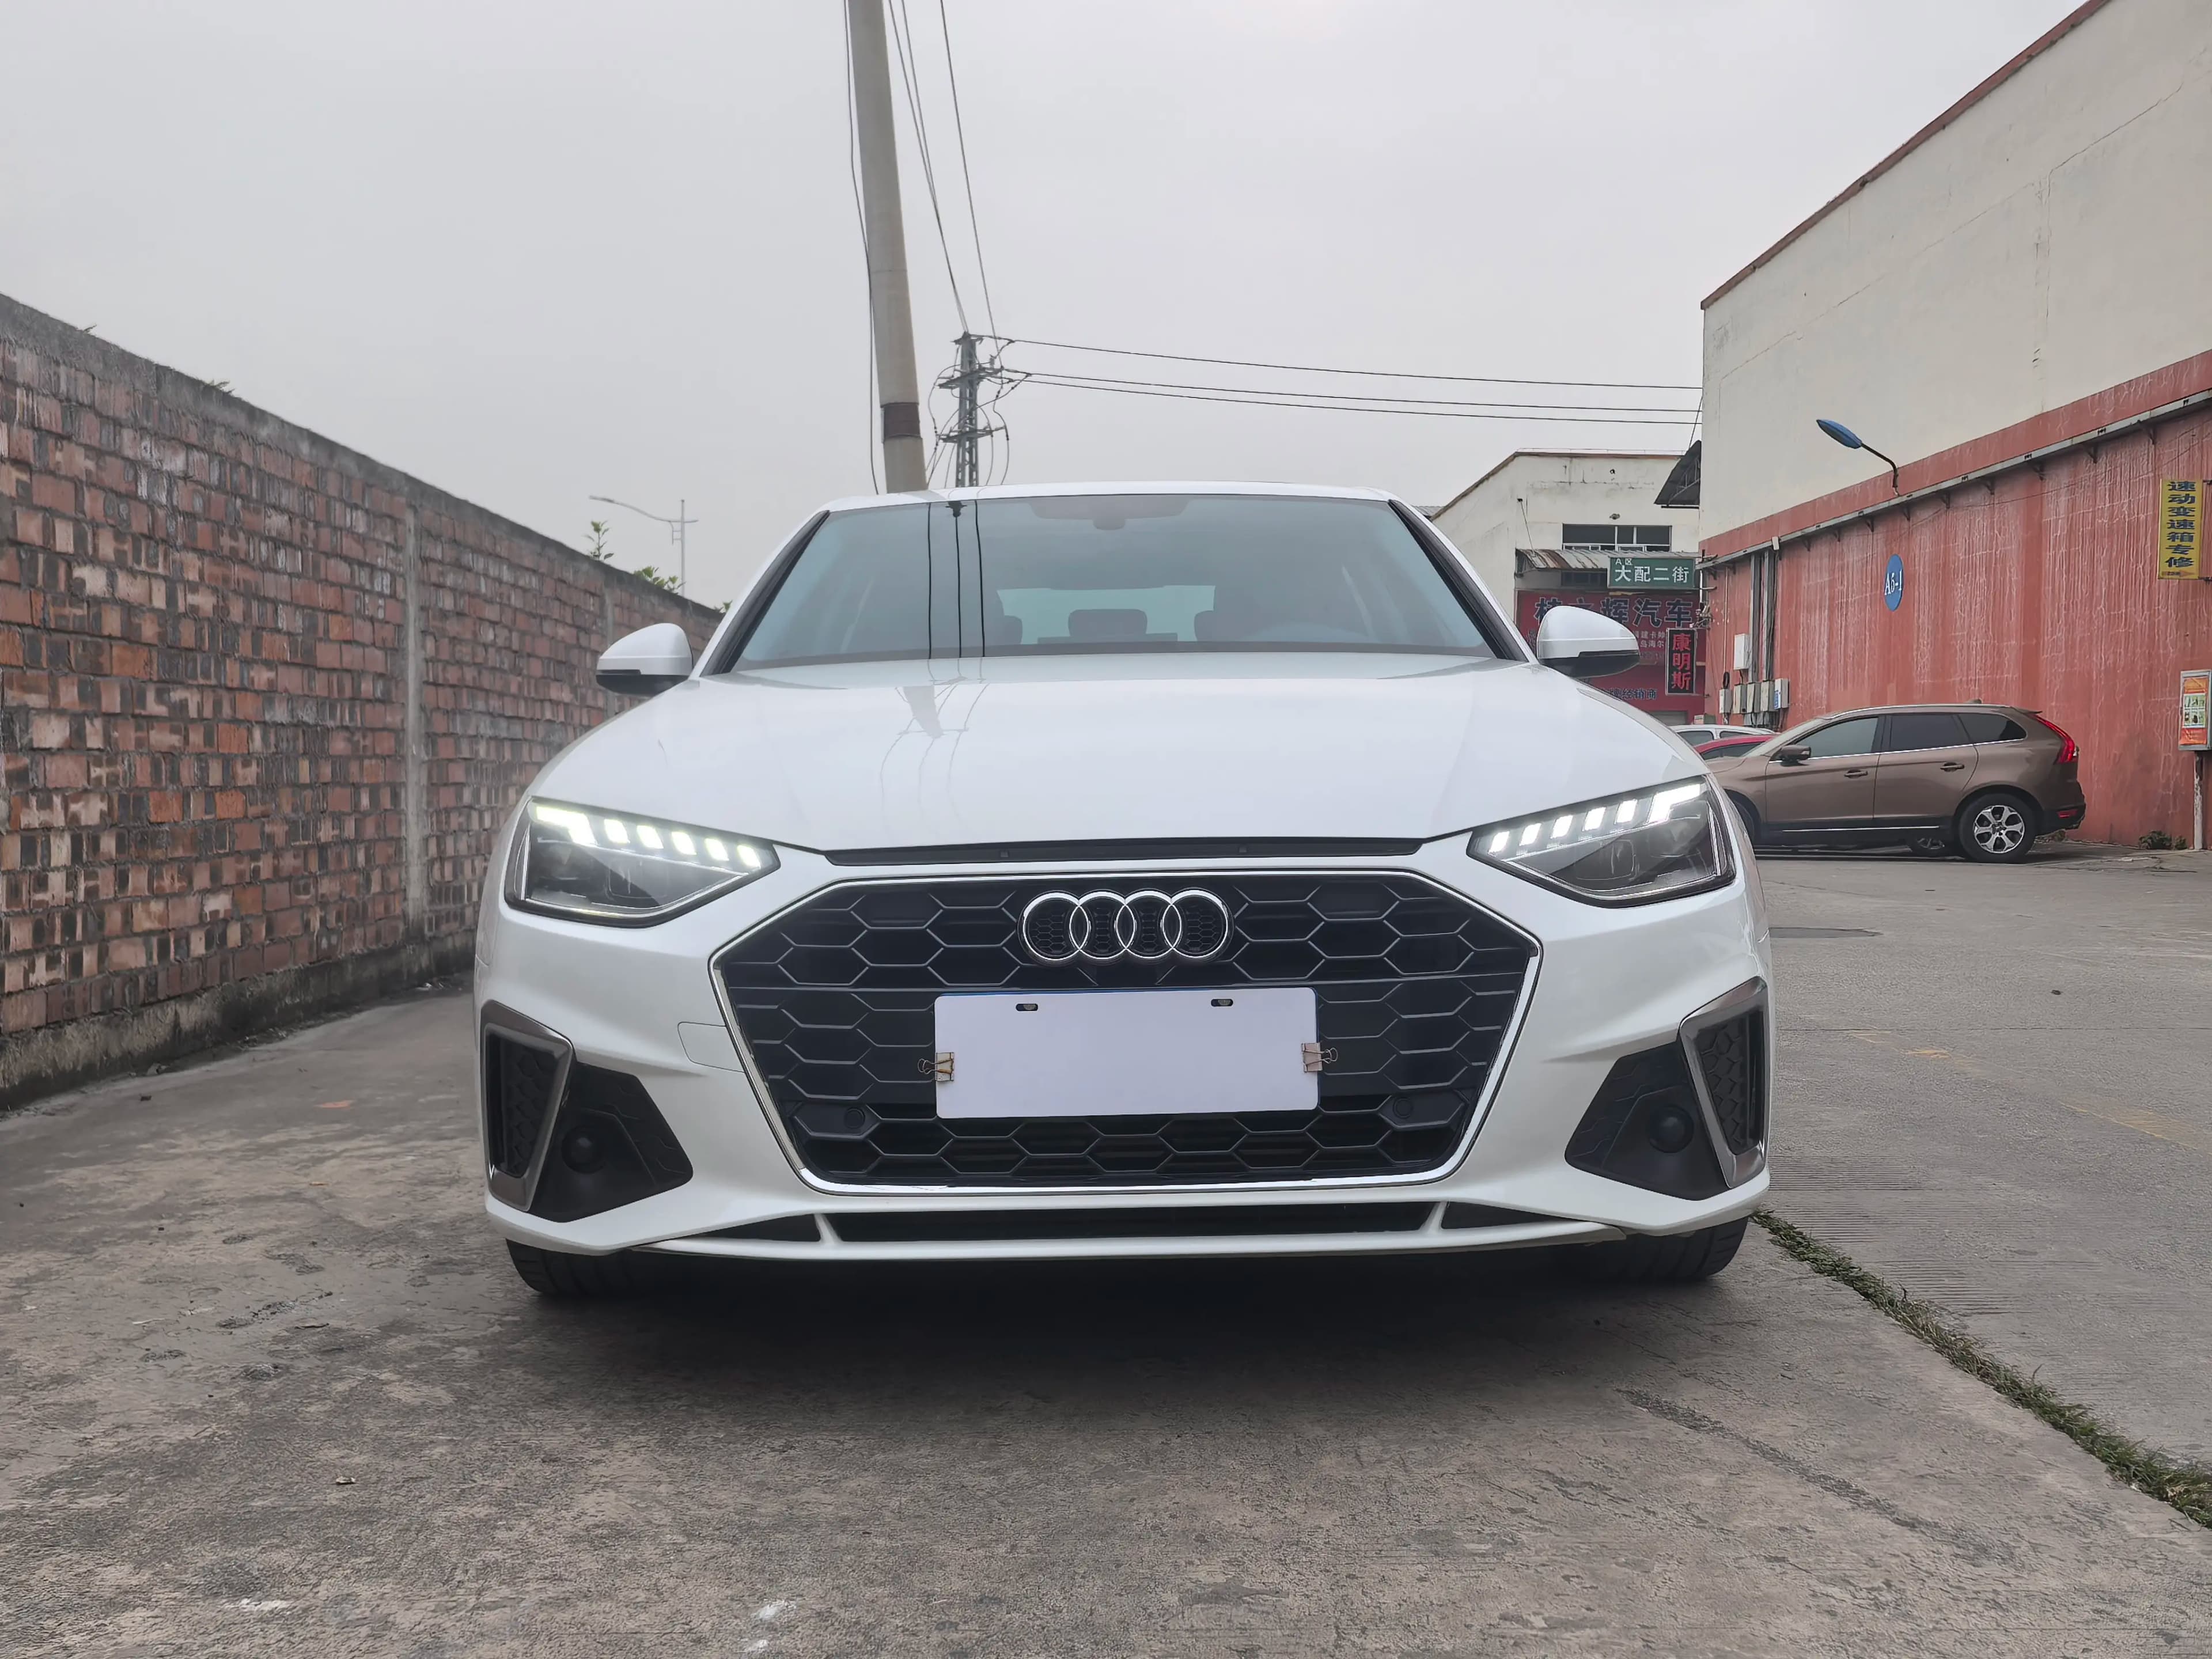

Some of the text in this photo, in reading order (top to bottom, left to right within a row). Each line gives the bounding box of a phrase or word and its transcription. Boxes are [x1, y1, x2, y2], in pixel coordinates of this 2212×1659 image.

[2164, 480, 2196, 567] 速动变速箱专修
[1615, 565, 1690, 583] 大配二街
[1671, 633, 1691, 690] 康明斯
